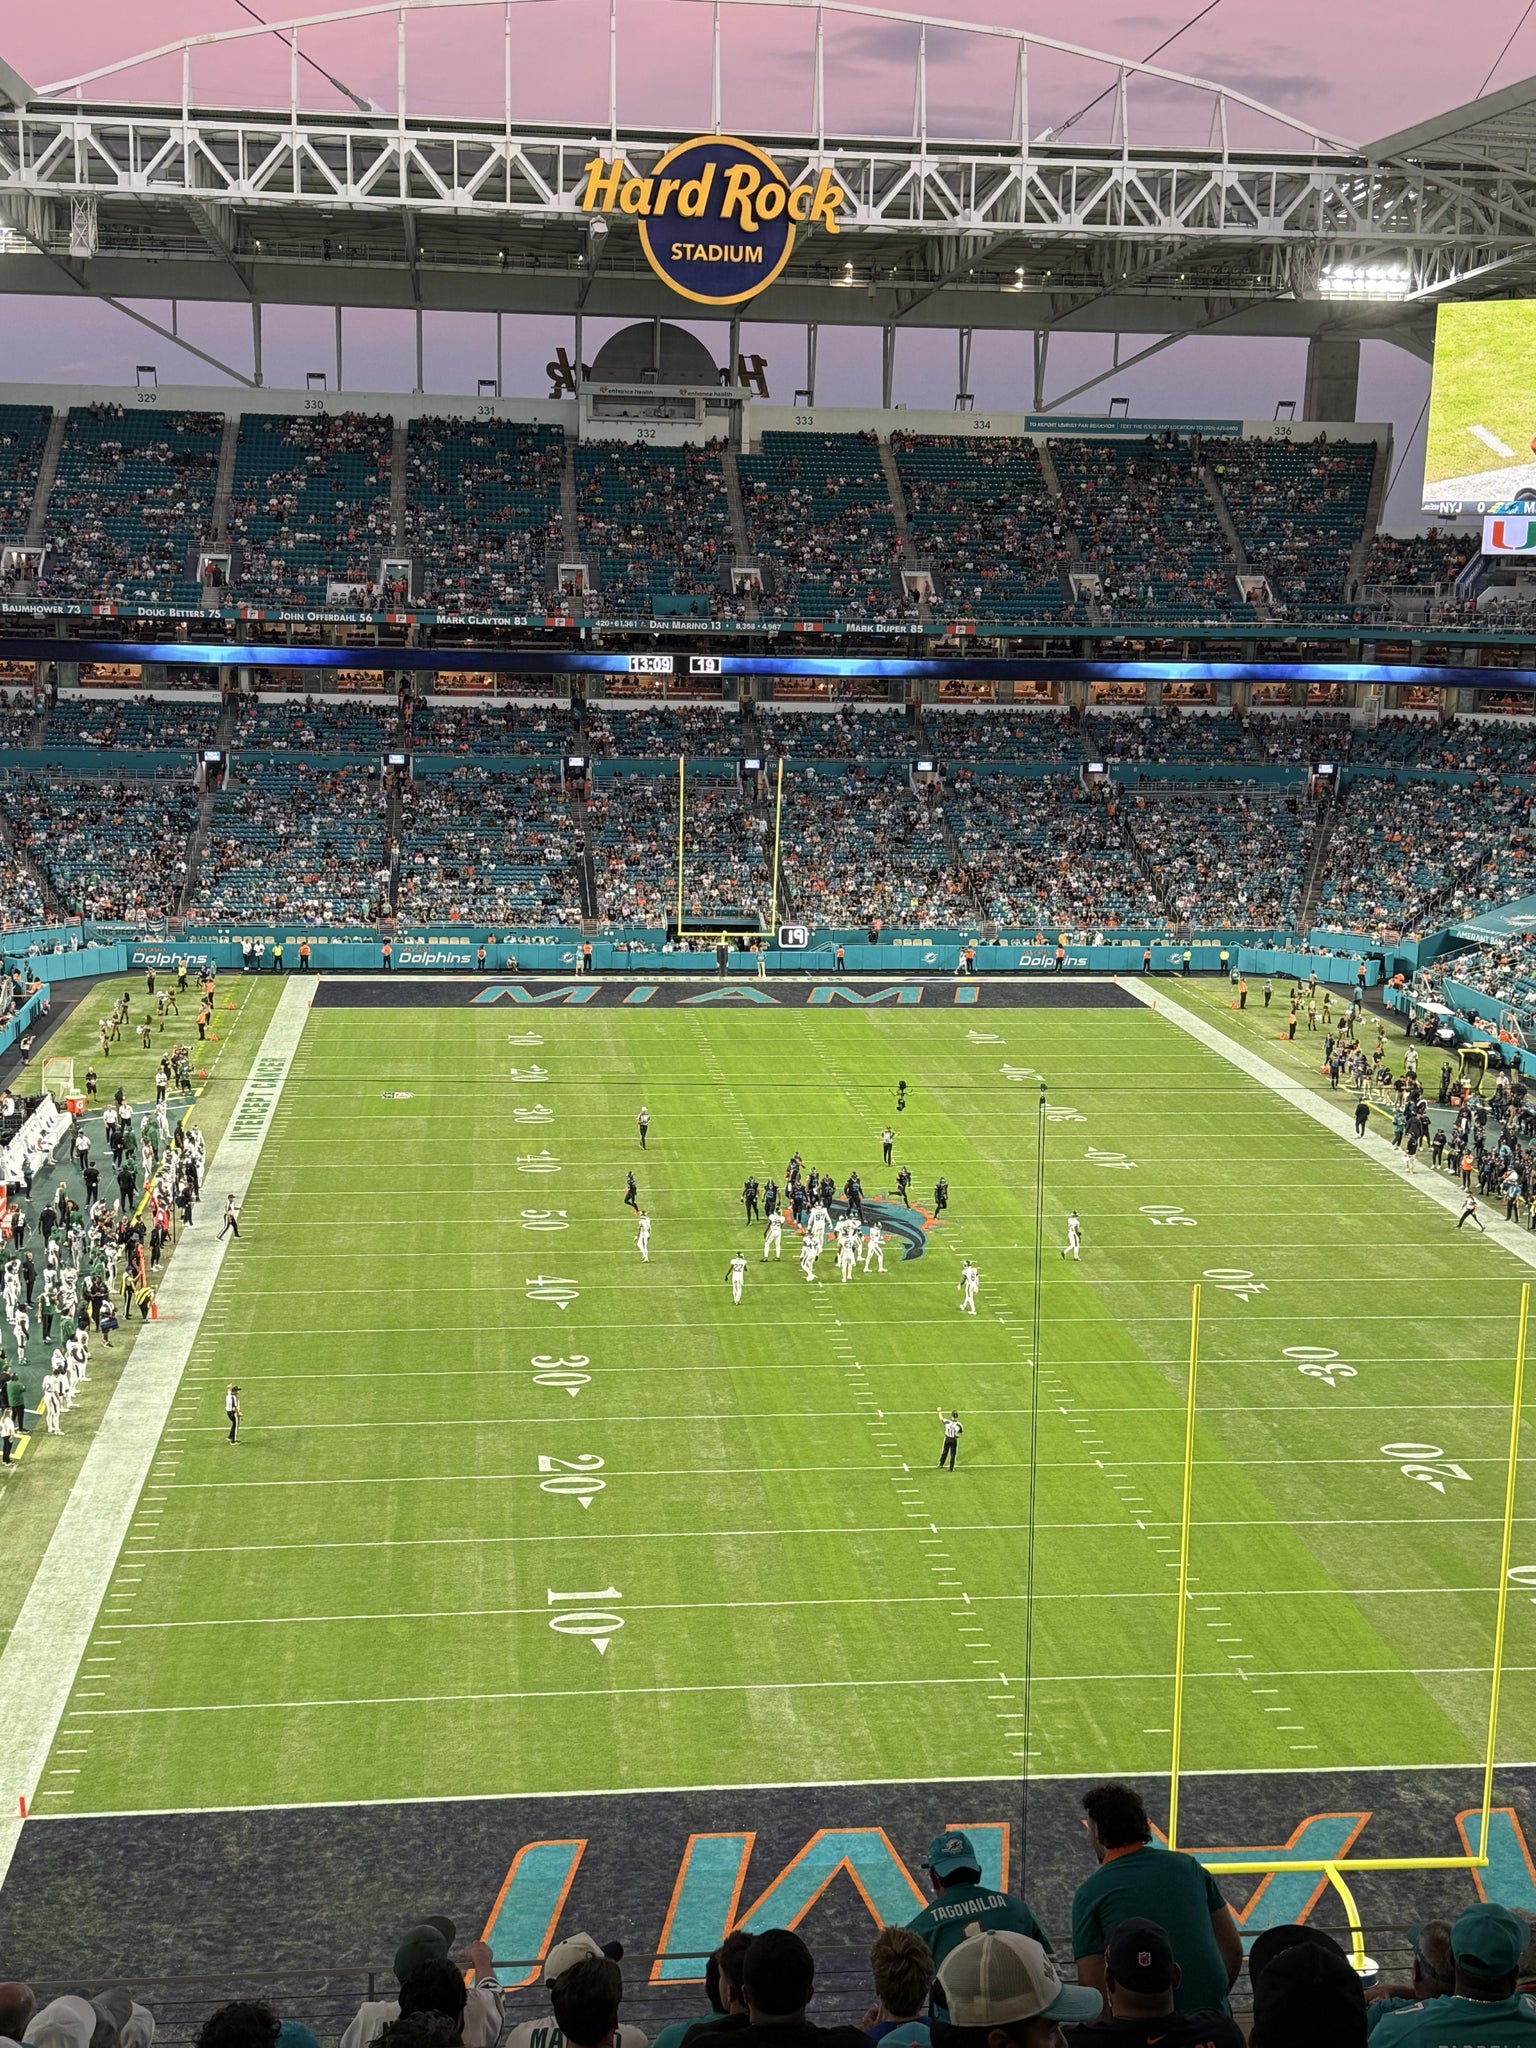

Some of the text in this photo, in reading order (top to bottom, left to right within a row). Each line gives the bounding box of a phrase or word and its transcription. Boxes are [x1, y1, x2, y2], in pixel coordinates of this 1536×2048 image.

[581, 157, 845, 234] Hard Rock
[671, 243, 763, 264] STADIUM
[137, 393, 157, 403] 329
[304, 400, 324, 410] 330
[477, 406, 495, 416] 331
[795, 416, 813, 426] 333
[973, 420, 991, 430] 334
[637, 429, 656, 438] 332
[1274, 426, 1292, 436] 336
[1439, 502, 1462, 513] NYJ
[1477, 502, 1485, 512] 0
[2, 604, 81, 614] BAUMHOWER 73
[138, 607, 221, 618] DOUG BETTERS 75
[278, 611, 373, 622] JOHN OFFERDAHL 56
[436, 615, 528, 625] MARK CLAYTON 83
[649, 620, 669, 629] DAN
[671, 620, 708, 630] MARINO
[710, 622, 721, 630] 13
[846, 623, 924, 634] MARK DUPER 85
[632, 658, 670, 670] 13:09
[697, 658, 714, 670] 19
[789, 929, 803, 944] 19
[132, 952, 208, 966] Dolphins
[398, 952, 472, 966] Dolphins
[1019, 954, 1088, 968] Dolpins
[469, 985, 980, 1004] MIAMI
[508, 1034, 544, 1046] 10
[510, 1068, 549, 1082] 20
[999, 1068, 1046, 1081] 20
[228, 1057, 287, 1141] INTERCEPT CANCER
[513, 1108, 555, 1123] 30
[1041, 1106, 1087, 1122] 30
[516, 1155, 562, 1173] 40
[1084, 1152, 1139, 1170] 40
[521, 1209, 570, 1231] 50
[1138, 1205, 1198, 1226] 50
[733, 1263, 743, 1272] 22
[526, 1275, 579, 1300] 40
[1203, 1268, 1269, 1294] 40
[1281, 1346, 1358, 1377] 30
[531, 1355, 592, 1386] 30
[1380, 1442, 1474, 1481] 20
[537, 1454, 607, 1494] 20
[547, 1586, 625, 1634] 10
[930, 1895, 1007, 1922] TAGOVAILOA
